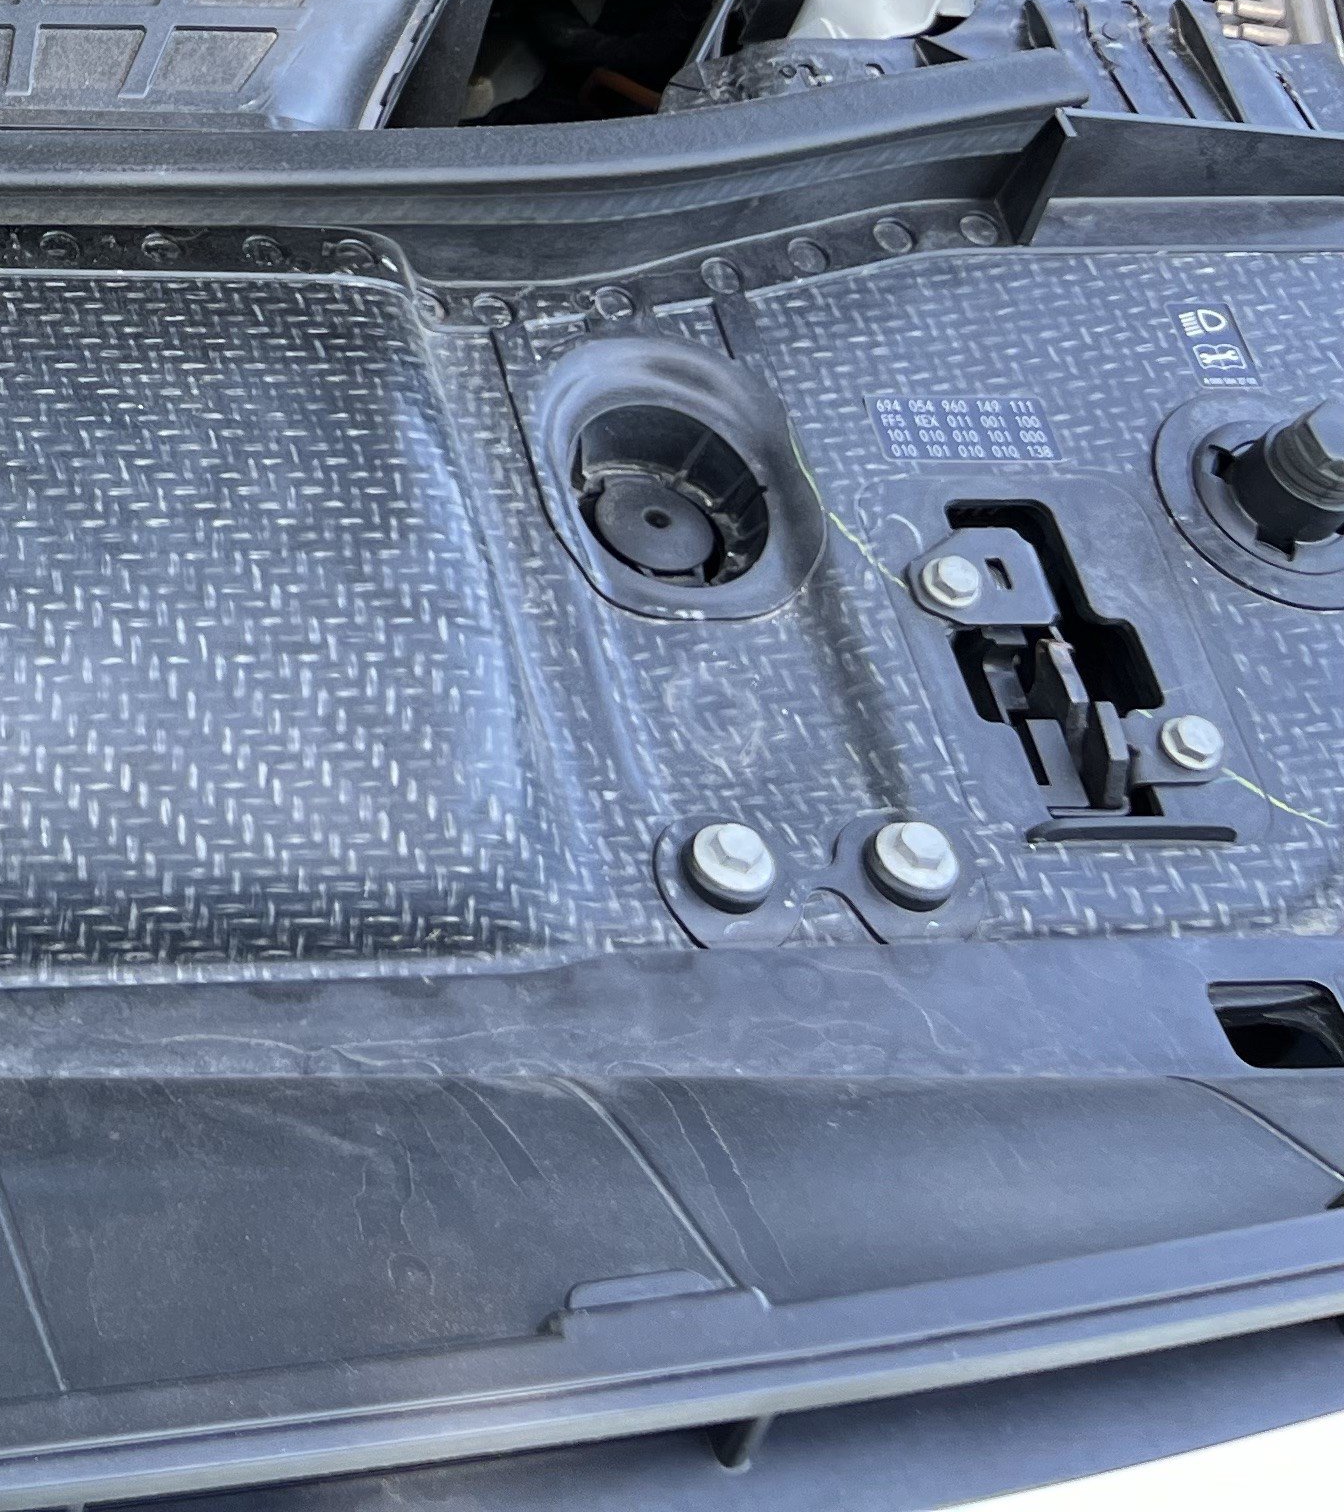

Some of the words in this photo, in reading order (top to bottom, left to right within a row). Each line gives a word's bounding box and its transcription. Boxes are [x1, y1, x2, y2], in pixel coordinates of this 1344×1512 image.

[876, 399, 902, 413] 694
[908, 399, 935, 413] 054
[941, 399, 969, 413] 960
[1009, 400, 1035, 414] 111
[946, 415, 974, 428] 011
[980, 415, 1007, 428] 001
[1015, 415, 1042, 429] 100
[887, 428, 912, 442] 101
[918, 429, 947, 443] 010
[952, 429, 980, 443] 010
[987, 430, 1013, 443] 101
[1019, 430, 1048, 443] 000
[891, 443, 919, 457] 010
[926, 444, 952, 457] 101
[957, 445, 987, 458] 010
[991, 445, 1021, 459] 010
